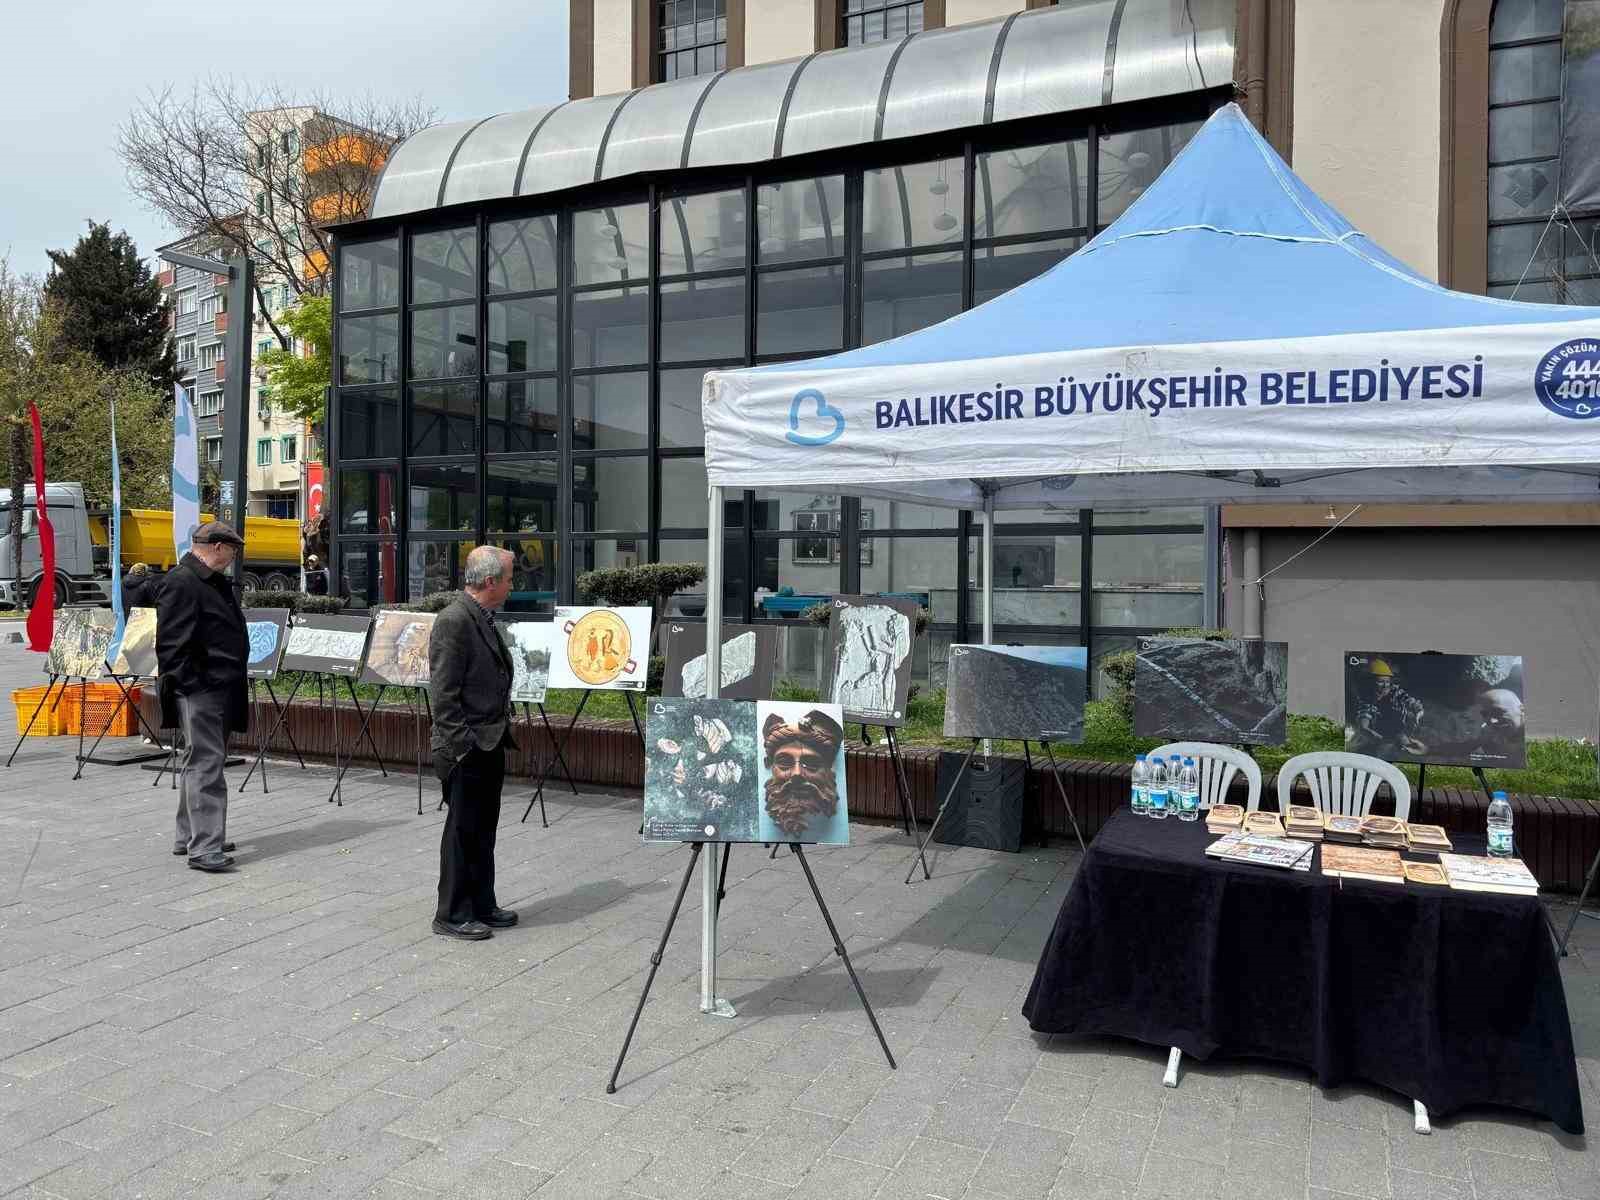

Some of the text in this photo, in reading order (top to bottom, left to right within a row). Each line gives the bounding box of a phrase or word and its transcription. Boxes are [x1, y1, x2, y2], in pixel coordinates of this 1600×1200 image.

[1541, 355, 1562, 382] YAKIN
[1562, 359, 1600, 379] 444
[875, 355, 1483, 429] BALIKESİR BÜYÜKŞEHİR BELEDİYESİ
